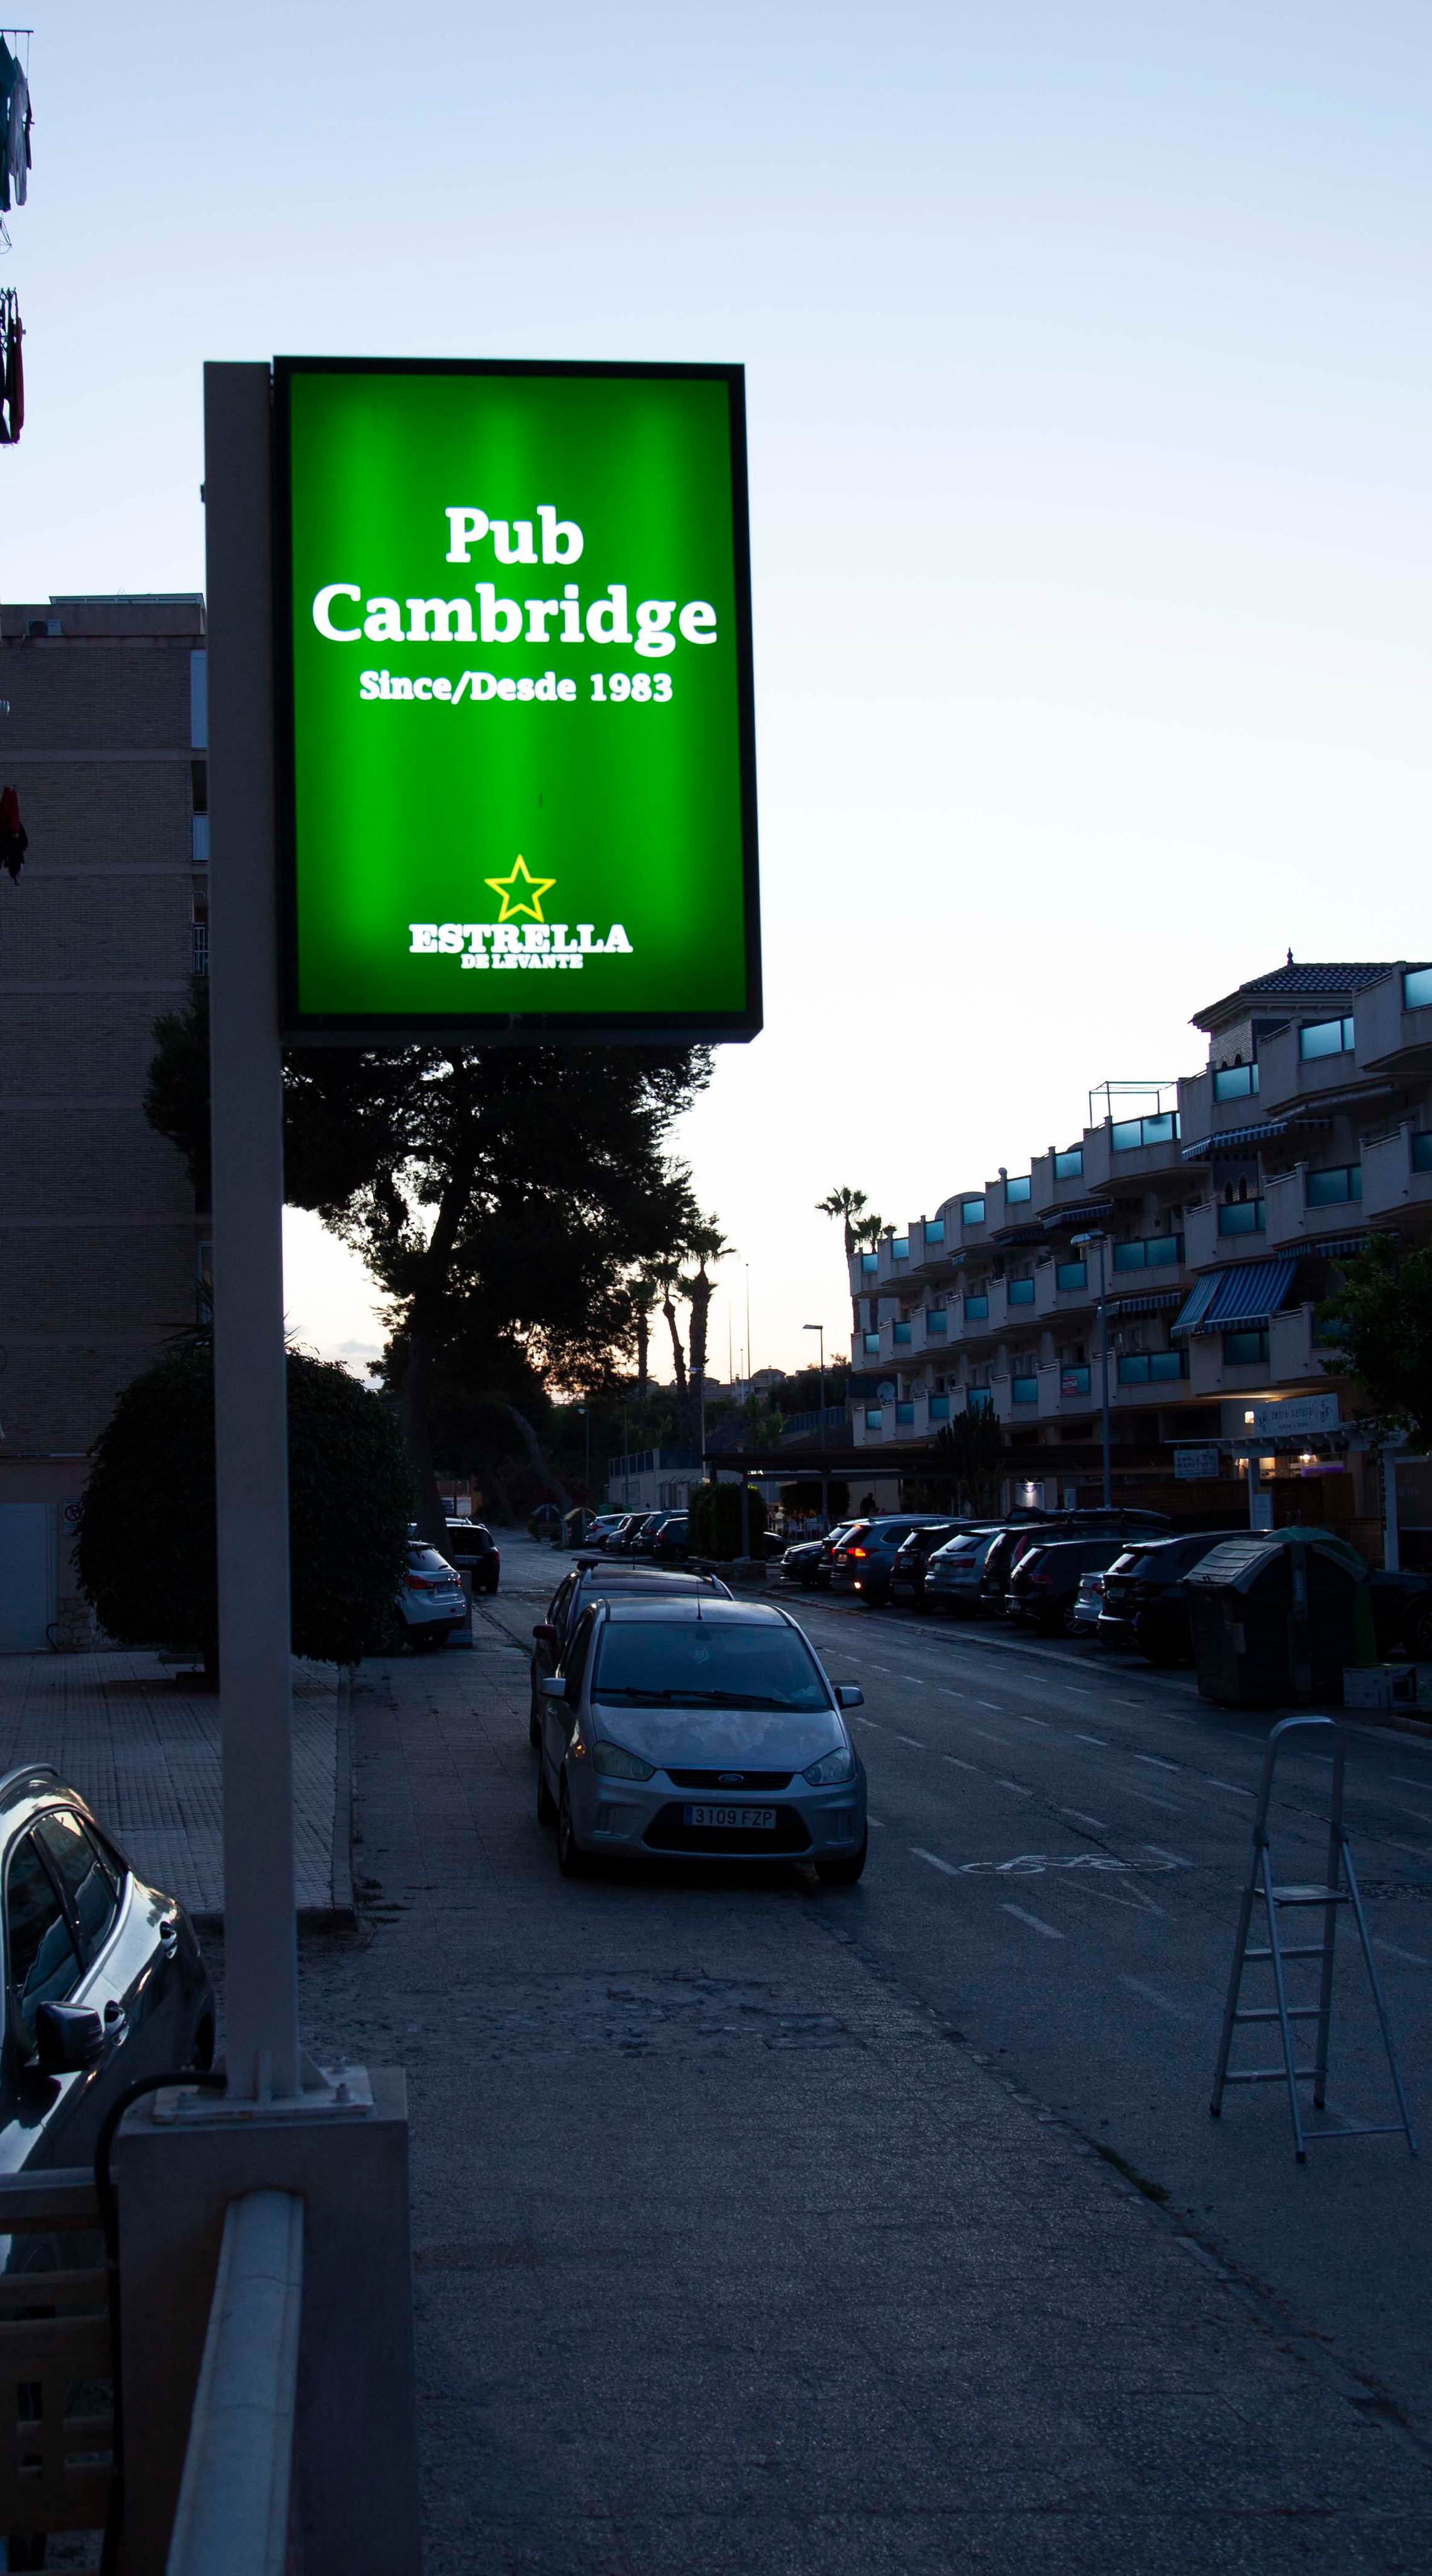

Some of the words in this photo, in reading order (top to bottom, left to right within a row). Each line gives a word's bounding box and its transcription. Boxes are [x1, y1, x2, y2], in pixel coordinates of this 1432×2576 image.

[445, 504, 584, 565] Pub
[313, 582, 717, 658] Cambridge
[360, 669, 577, 704] Since/Desde
[590, 673, 673, 702] 1983
[408, 923, 634, 954] ESTRELLA
[460, 953, 490, 969] DE
[491, 953, 584, 969] LEVANTE
[696, 1809, 736, 1824] 3109
[742, 1811, 772, 1826] FZP
